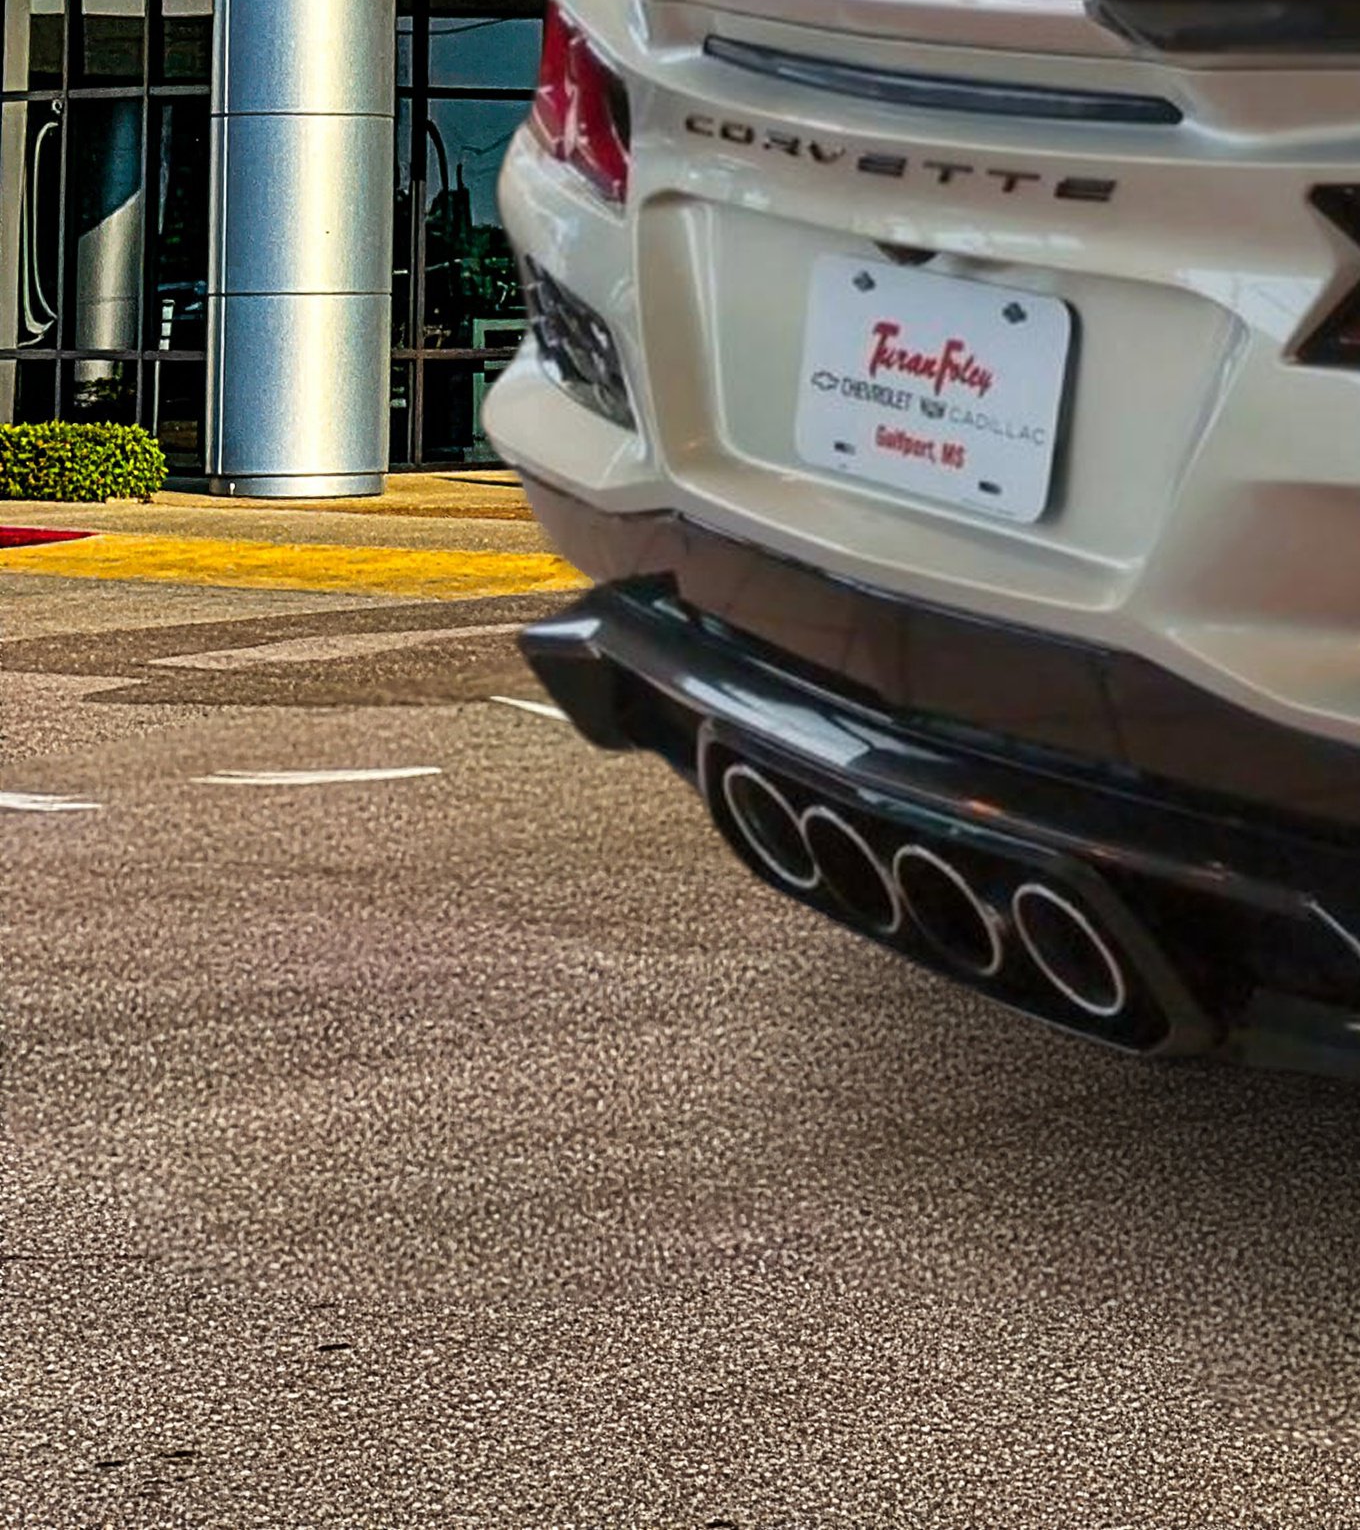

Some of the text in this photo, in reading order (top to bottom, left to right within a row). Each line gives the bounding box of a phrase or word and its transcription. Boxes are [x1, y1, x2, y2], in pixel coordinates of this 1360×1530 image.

[684, 113, 1118, 203] CORVETTE
[840, 376, 1046, 447] CHEVROLET CADILLAC
[941, 442, 966, 469] MS
